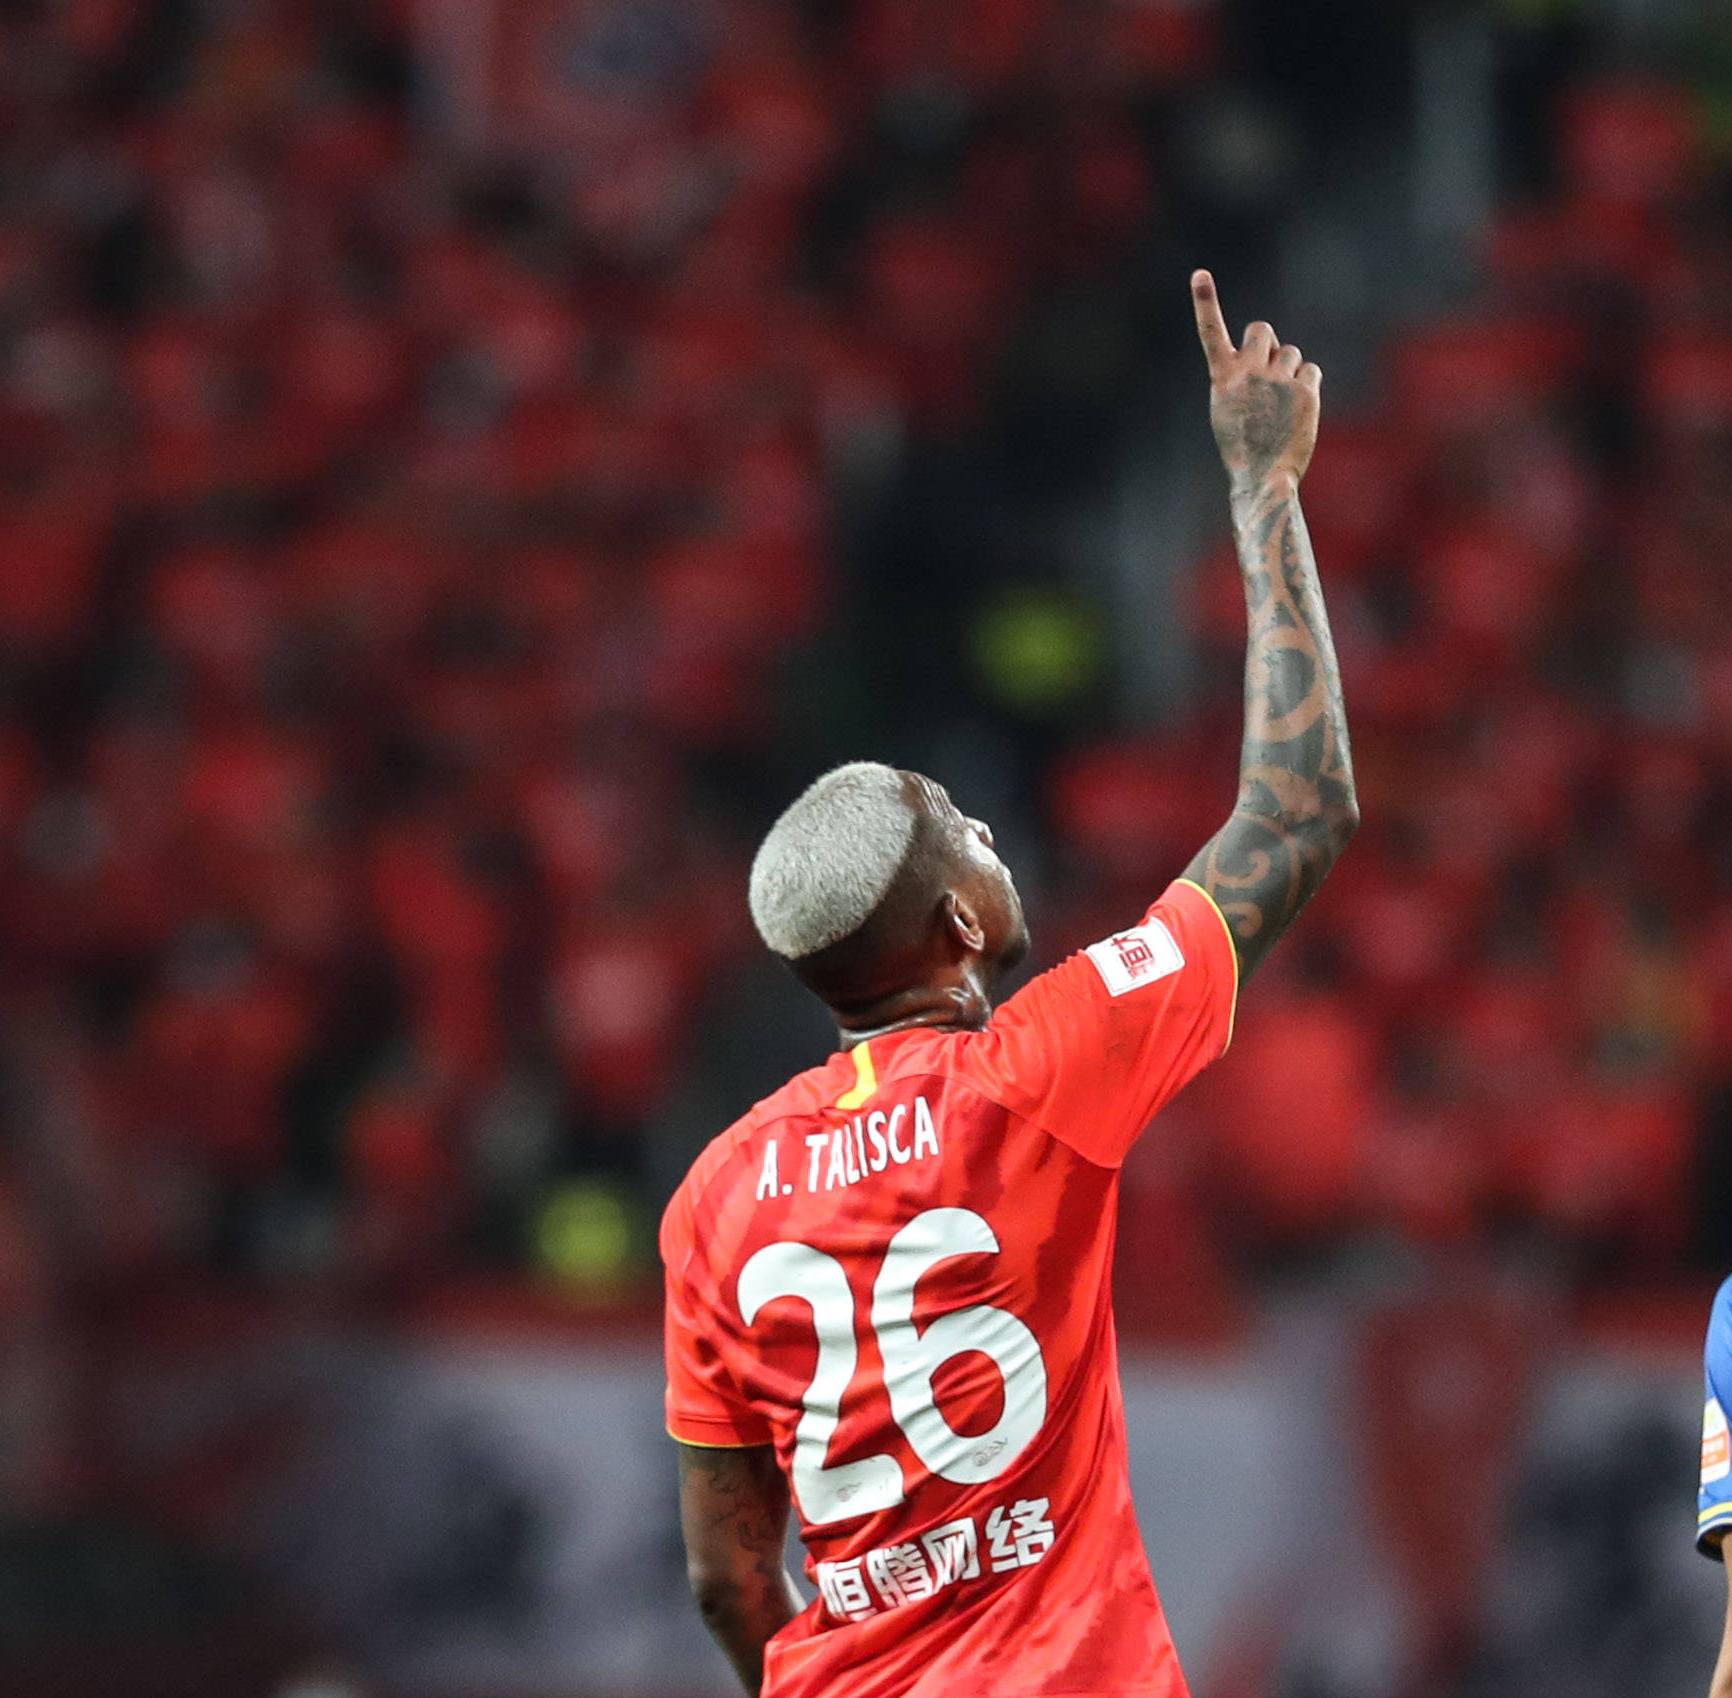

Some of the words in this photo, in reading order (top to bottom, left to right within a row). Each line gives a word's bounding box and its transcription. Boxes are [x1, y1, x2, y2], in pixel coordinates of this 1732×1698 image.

[756, 1139, 793, 1201] A.
[805, 1096, 939, 1193] TALISCA
[736, 1206, 1048, 1525] 26
[817, 1497, 1056, 1621] 恒腾网络
